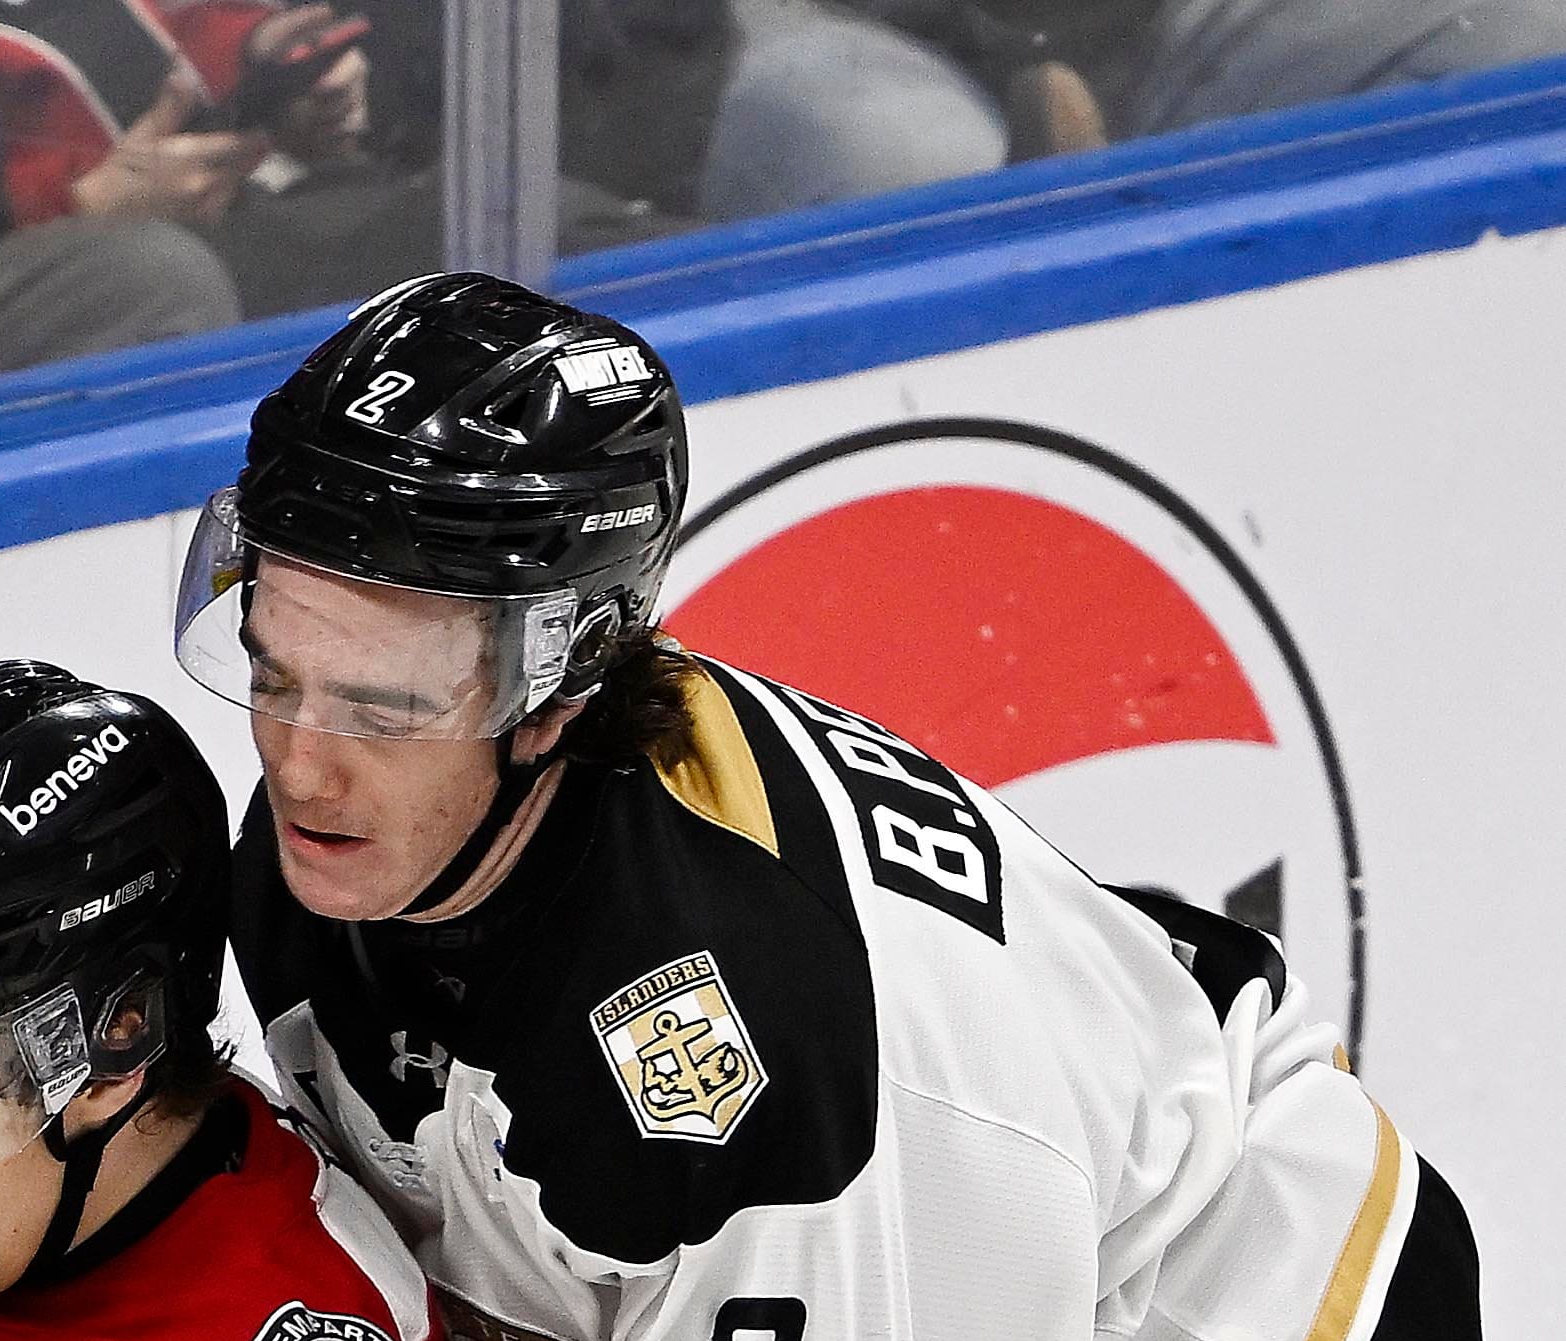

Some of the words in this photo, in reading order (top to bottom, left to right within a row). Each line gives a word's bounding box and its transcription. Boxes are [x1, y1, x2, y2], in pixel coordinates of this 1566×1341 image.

[345, 370, 416, 425] 2
[580, 503, 655, 534] BAUER
[0, 724, 130, 836] beneva
[59, 870, 156, 932] BAUER
[593, 956, 712, 1029] ISLANDERS
